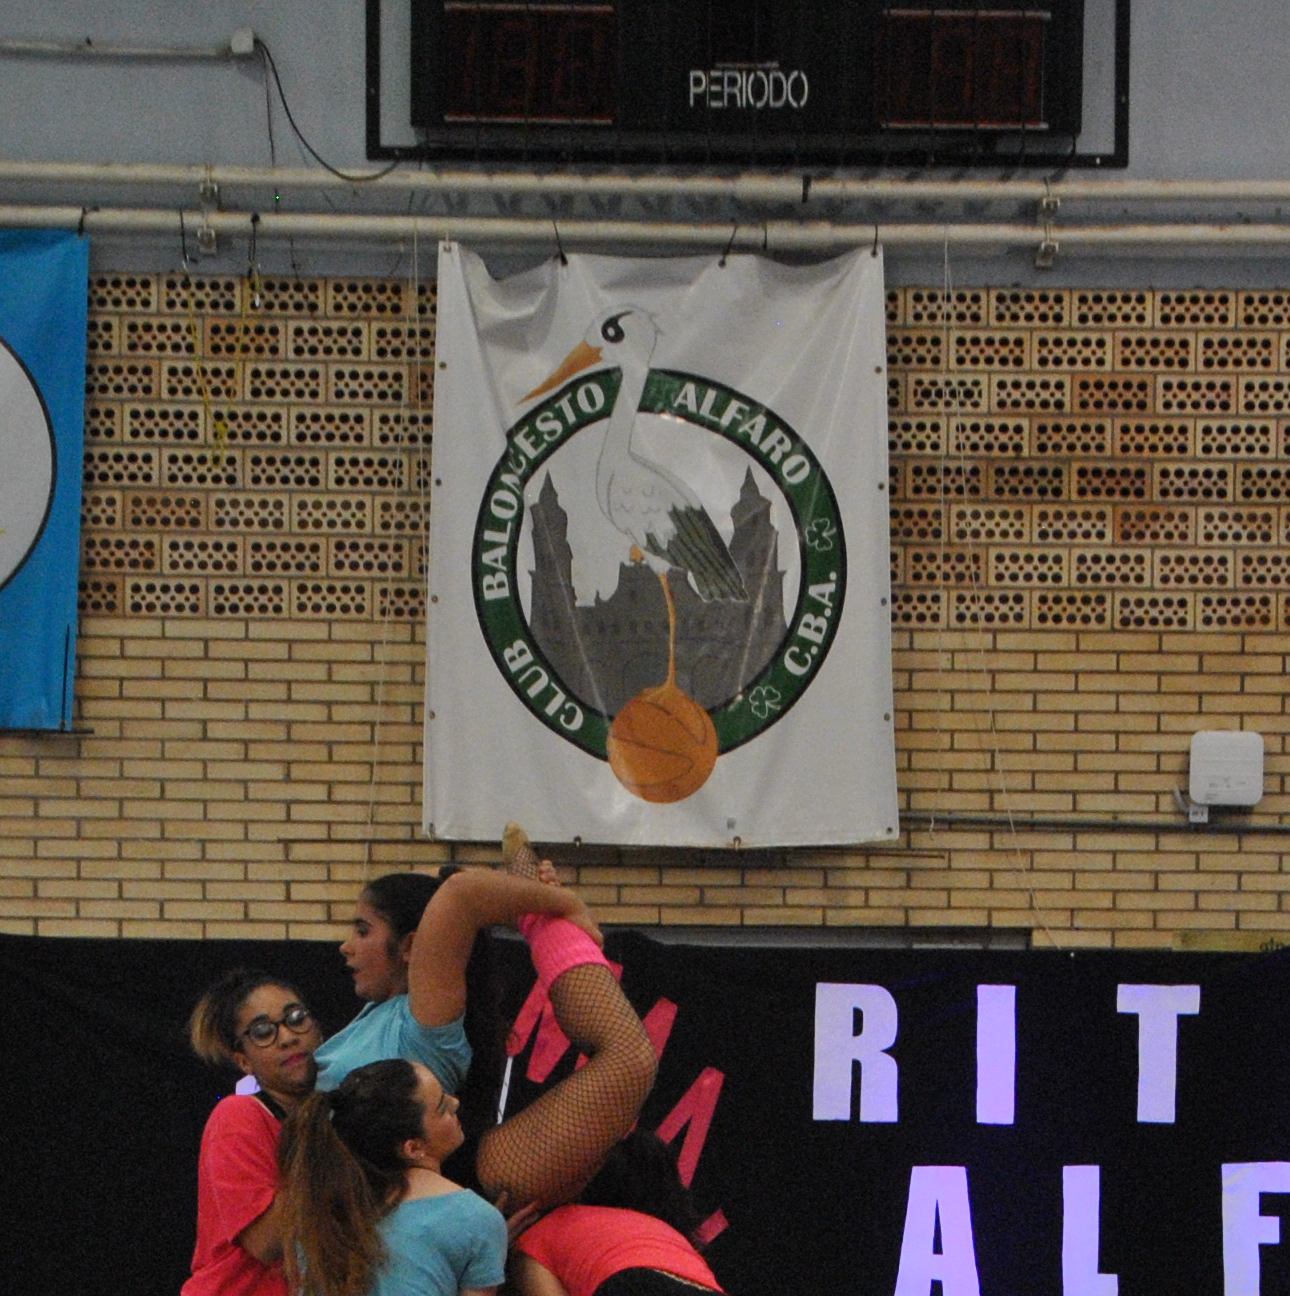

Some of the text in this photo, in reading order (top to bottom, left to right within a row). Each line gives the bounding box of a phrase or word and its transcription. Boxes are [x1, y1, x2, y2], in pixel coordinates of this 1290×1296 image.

[689, 69, 808, 108] PERIODO
[503, 638, 584, 731] CLUB
[673, 382, 810, 484] ALFARO
[783, 570, 837, 676] C.B.A.
